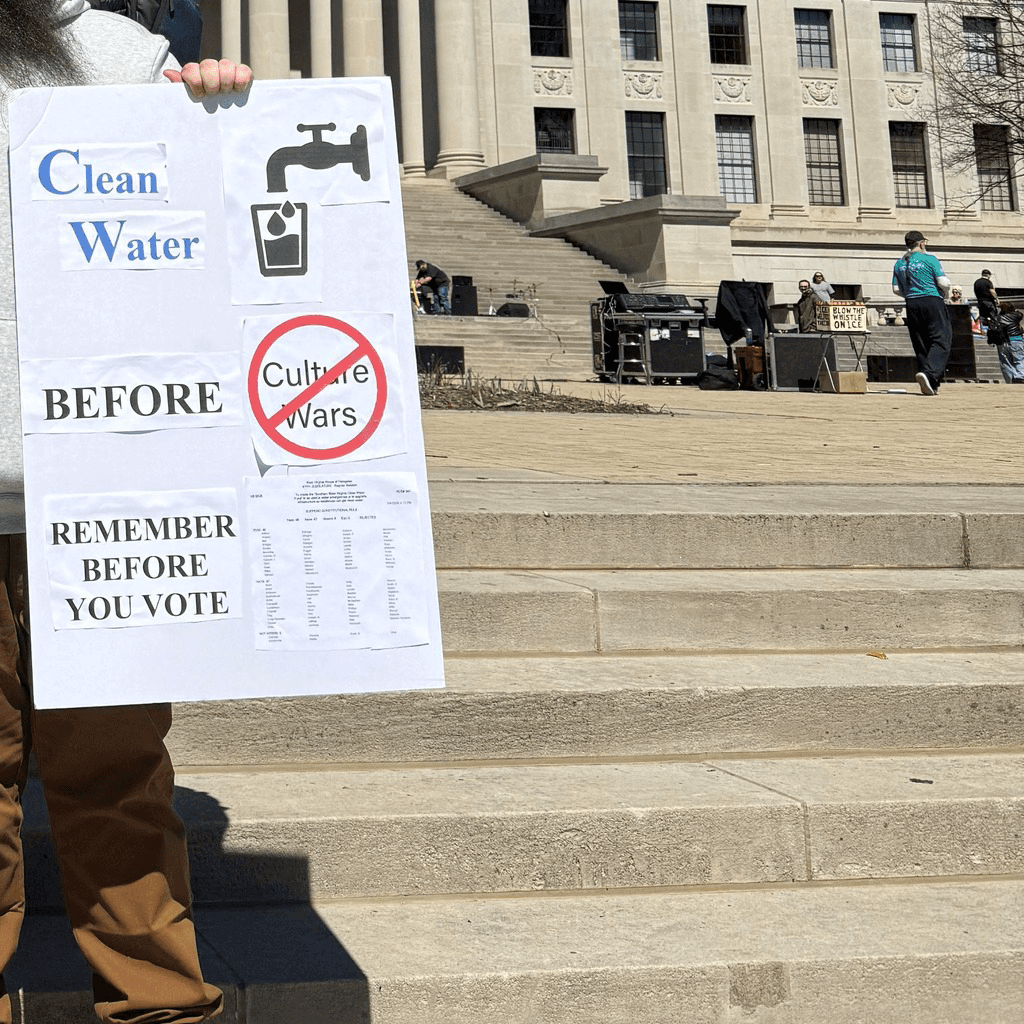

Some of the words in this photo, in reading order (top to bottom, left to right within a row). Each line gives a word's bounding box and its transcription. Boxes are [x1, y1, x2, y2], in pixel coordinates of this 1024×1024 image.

[38, 149, 158, 195] Clean
[68, 220, 199, 263] Water
[834, 321, 846, 329] ON
[847, 321, 863, 329] ICE
[42, 382, 222, 420] BEFORE
[282, 402, 357, 429] Wars
[51, 515, 236, 545] REMEMBER
[82, 554, 208, 582] BEFORE
[65, 595, 133, 621] YOU
[142, 591, 228, 617] VOTE
